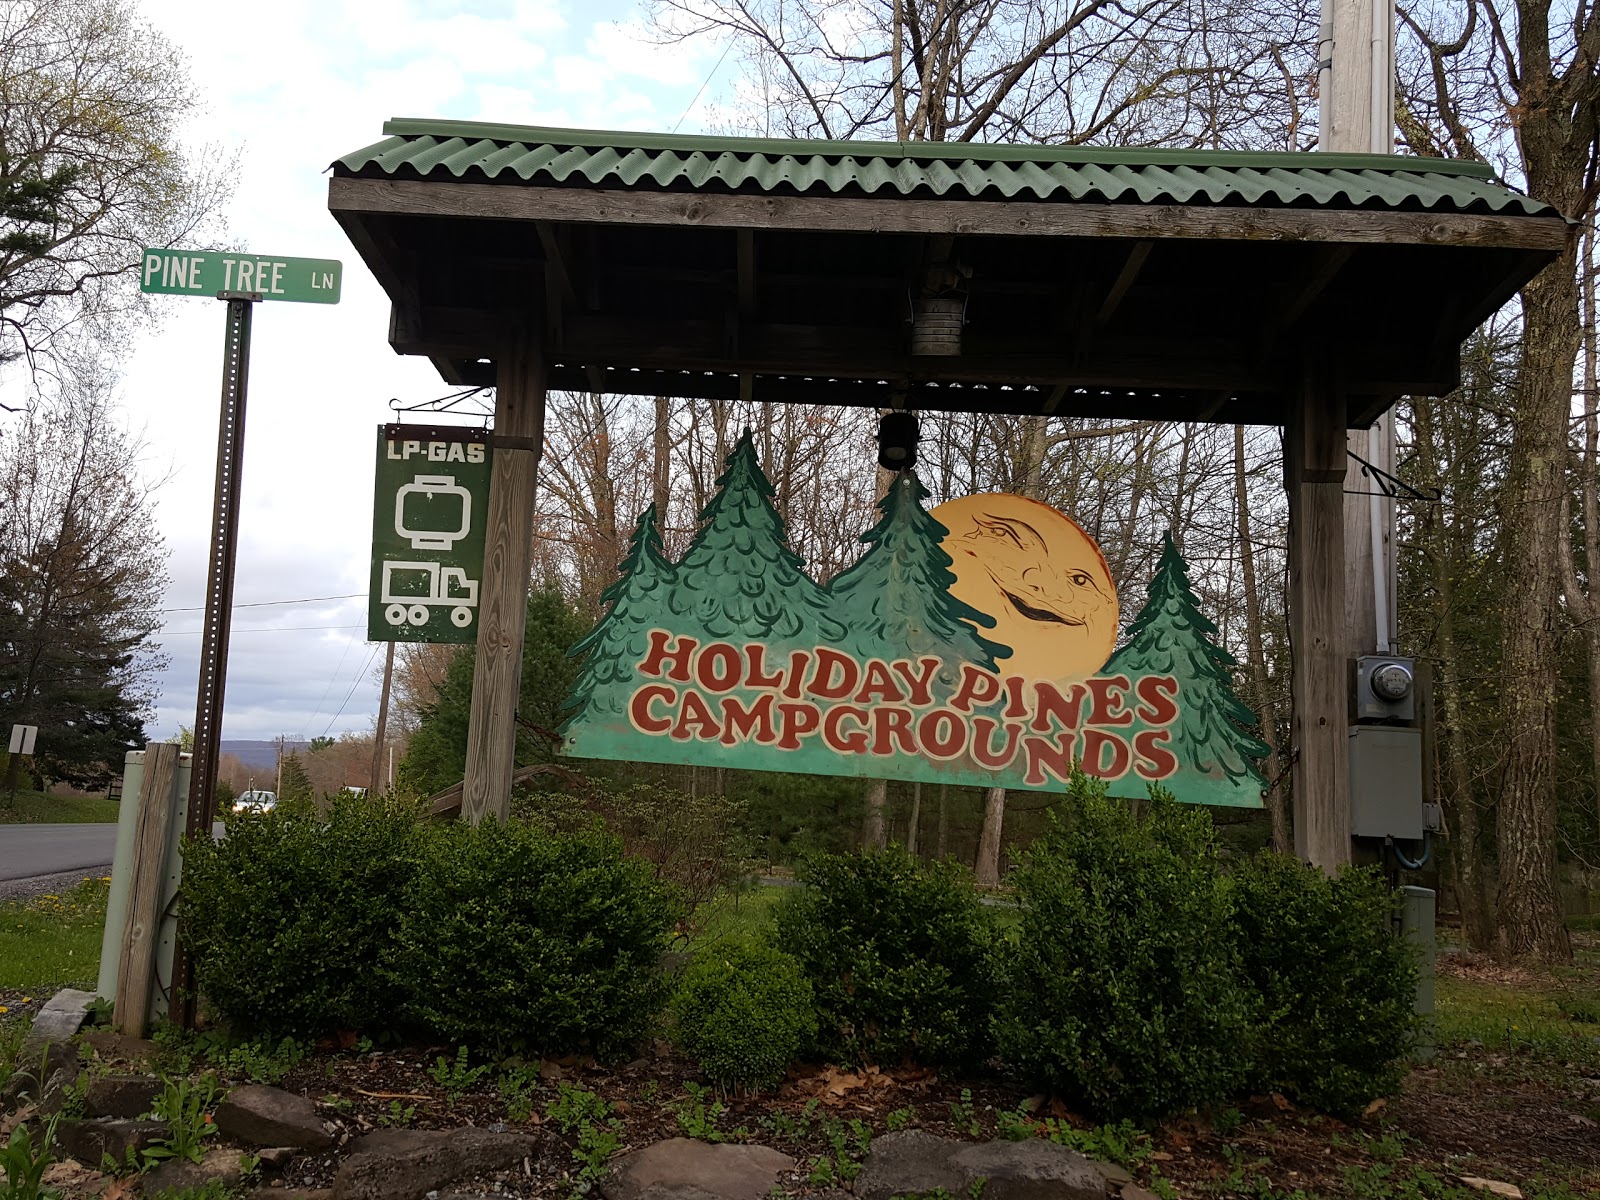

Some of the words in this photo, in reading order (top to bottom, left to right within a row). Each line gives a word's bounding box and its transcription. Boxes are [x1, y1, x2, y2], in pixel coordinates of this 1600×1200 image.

[144, 254, 205, 289] PINE
[222, 259, 287, 294] TREE
[311, 271, 334, 290] LN
[387, 439, 485, 464] LP-GAS
[636, 629, 941, 706] HOLIDAY
[947, 674, 1178, 733] PINES
[630, 685, 1178, 785] CAMPGROUNDS
